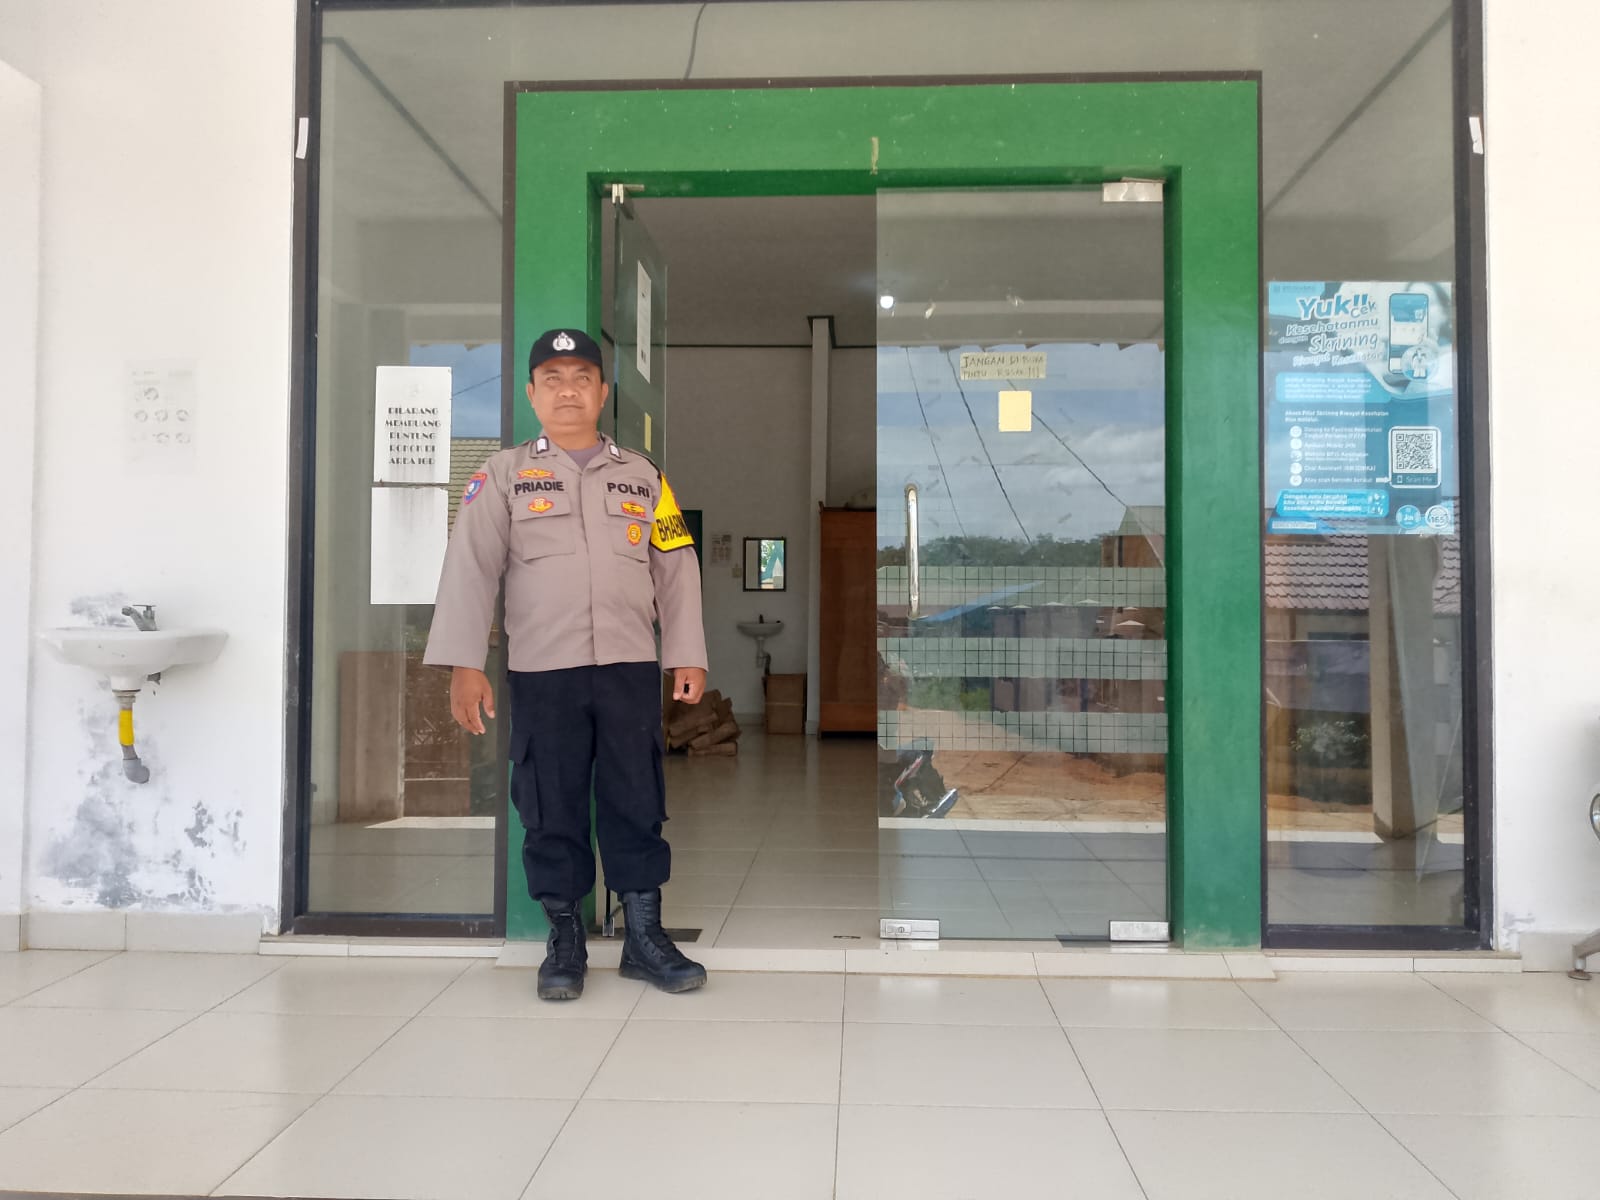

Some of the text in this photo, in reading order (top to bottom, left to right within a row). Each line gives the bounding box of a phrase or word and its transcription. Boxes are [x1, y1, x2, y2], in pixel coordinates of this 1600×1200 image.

[1298, 293, 1369, 320] Yuk!!
[1351, 301, 1376, 318] Cek
[1286, 318, 1378, 336] Kesehatanmu
[1309, 332, 1378, 354] Skrining
[961, 355, 1005, 368] JANGAN
[388, 407, 438, 415] DILARANG
[385, 419, 441, 427] MEMBUANG
[514, 481, 565, 495] PRIADIE
[607, 482, 650, 498] POLRI
